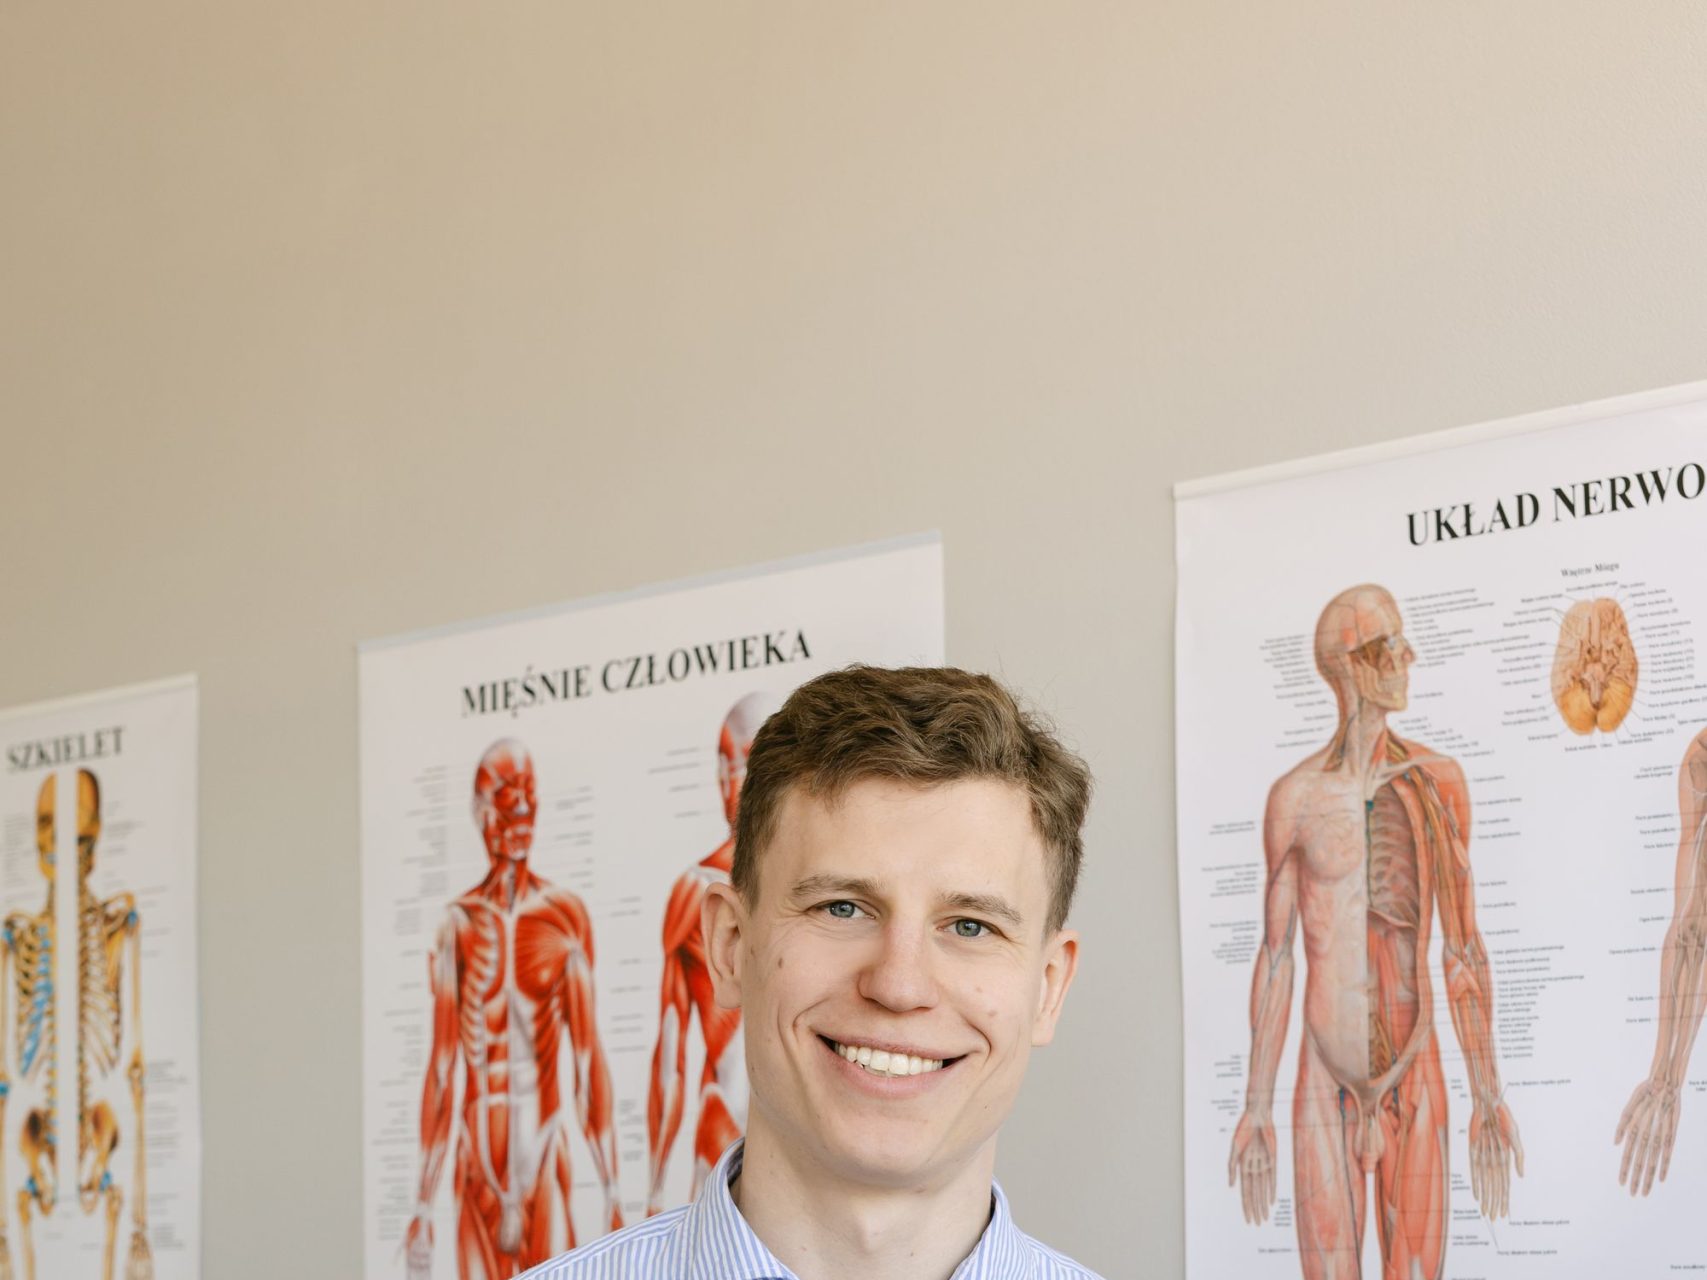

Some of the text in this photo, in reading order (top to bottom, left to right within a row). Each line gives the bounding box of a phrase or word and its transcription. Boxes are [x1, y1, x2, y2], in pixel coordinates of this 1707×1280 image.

[1407, 462, 1706, 546] UKŁAD NERWO
[461, 628, 811, 718] MIĘŚNIE CZŁOWIEKA
[6, 726, 125, 773] SZKIELET
